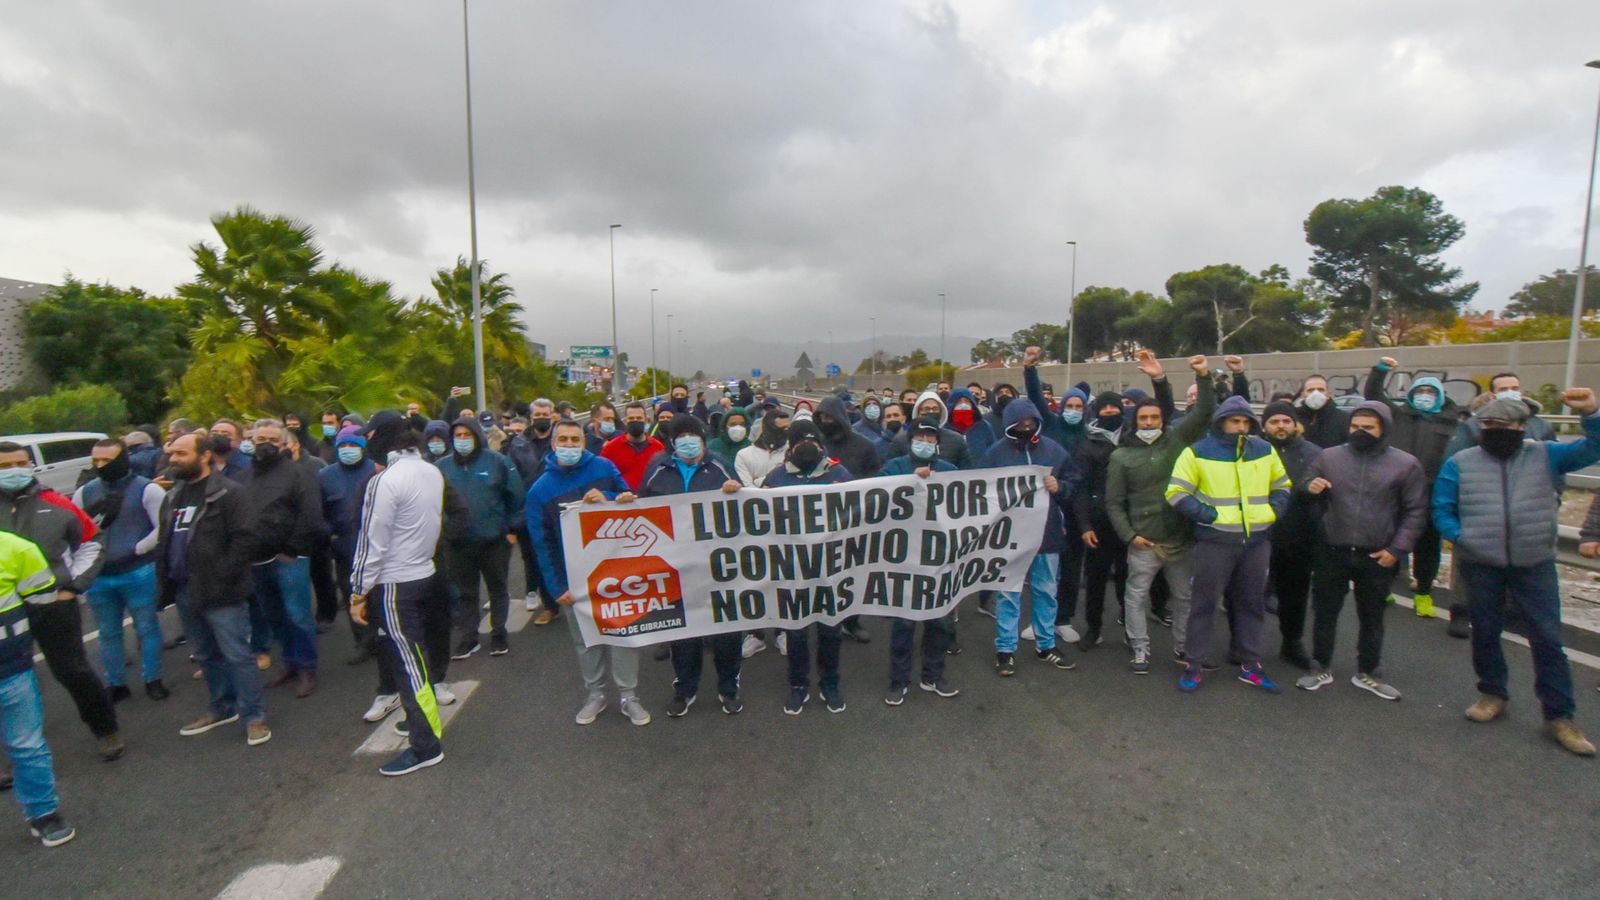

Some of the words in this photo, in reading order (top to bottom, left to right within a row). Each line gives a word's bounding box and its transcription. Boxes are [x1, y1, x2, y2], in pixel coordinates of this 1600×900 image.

[691, 486, 914, 541] LUCHEMOS
[926, 479, 988, 520] POR
[997, 475, 1037, 512] UN
[709, 528, 908, 582] CONVENIO
[597, 572, 671, 598] CGT
[710, 589, 766, 623] NO
[776, 576, 854, 620] MAS
[601, 597, 676, 619] METAL
[628, 625, 639, 634] DE
[640, 618, 682, 632] GIBRALTAR
